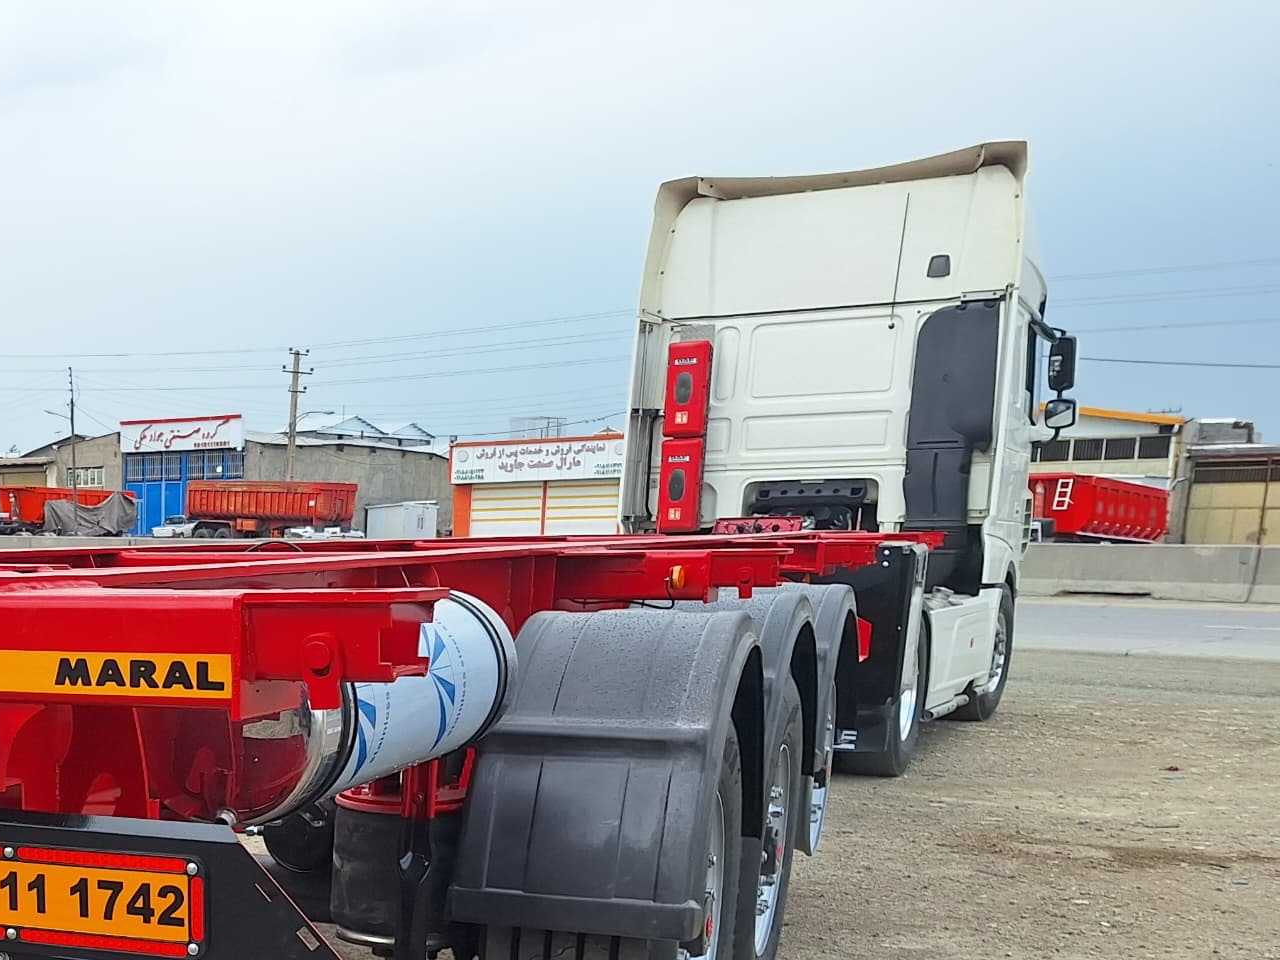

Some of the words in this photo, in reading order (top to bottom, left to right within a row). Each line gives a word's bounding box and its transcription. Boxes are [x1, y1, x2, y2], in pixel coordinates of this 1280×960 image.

[573, 443, 606, 455] نمایندگی
[54, 656, 226, 691] MARAL
[69, 876, 186, 928] 1742
